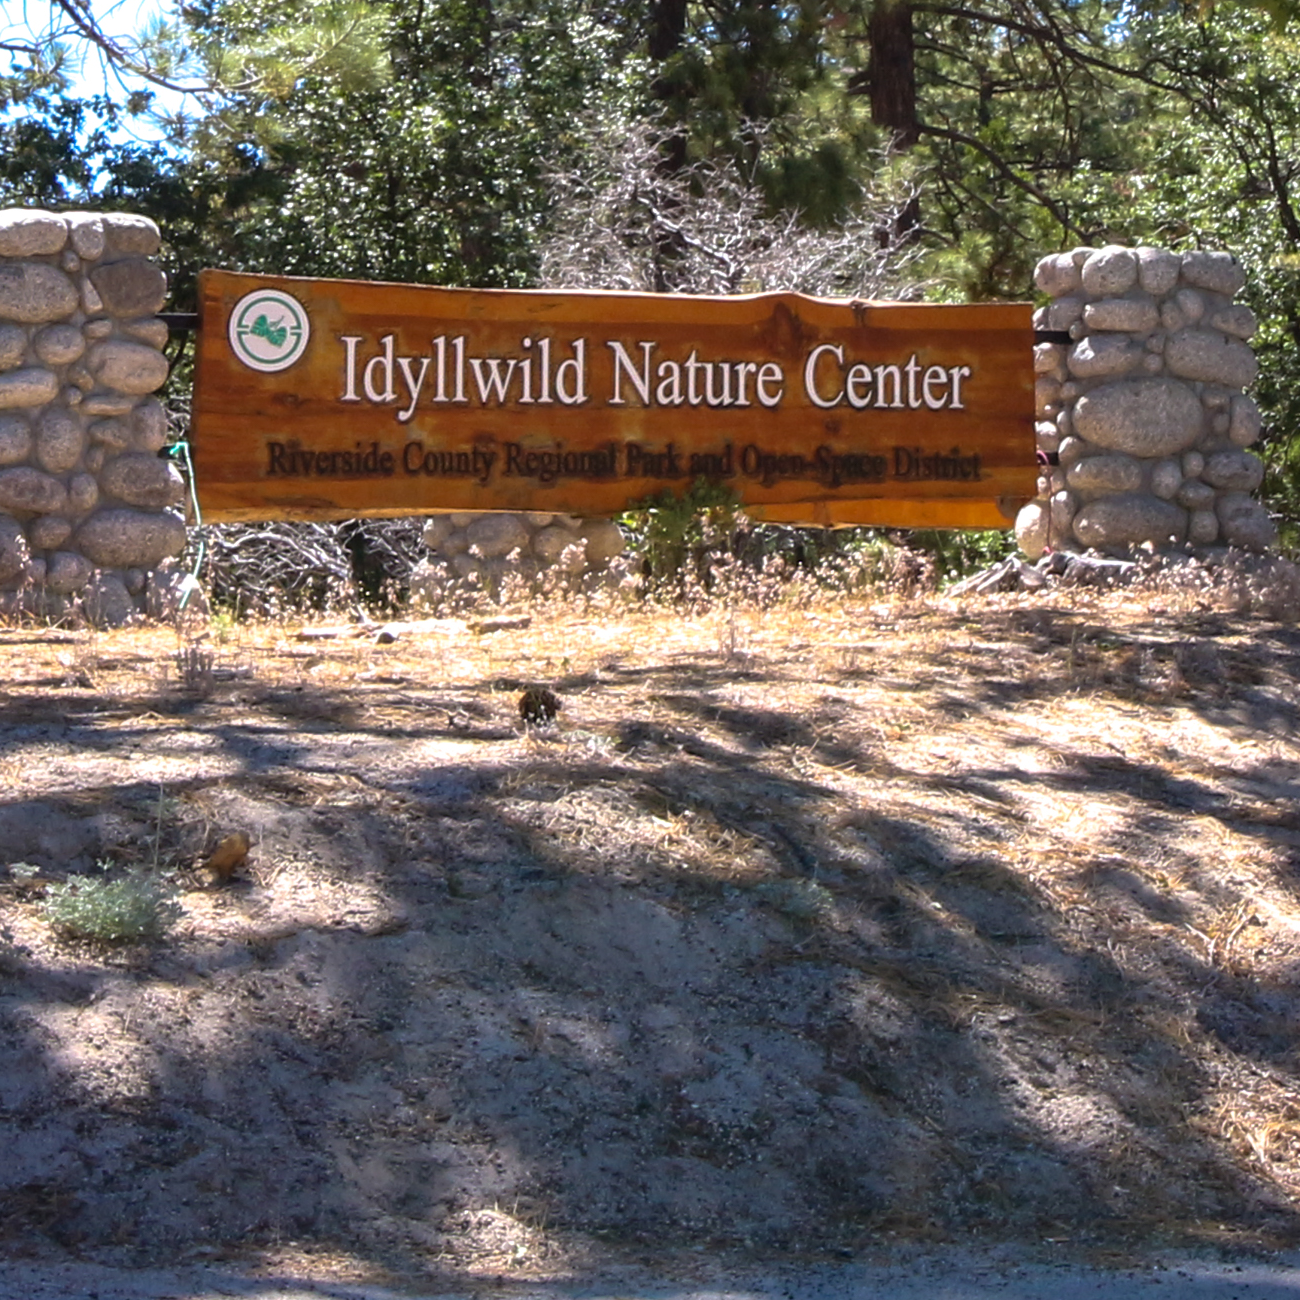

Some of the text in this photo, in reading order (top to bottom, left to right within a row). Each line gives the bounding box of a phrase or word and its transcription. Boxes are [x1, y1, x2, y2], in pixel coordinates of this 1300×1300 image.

[340, 334, 971, 422] Idyllwild Nature Center
[267, 441, 393, 475] Riverside
[403, 442, 494, 484] County
[503, 442, 617, 482] Regional
[625, 443, 679, 477] Park
[690, 442, 732, 475] and
[893, 446, 981, 482] District
